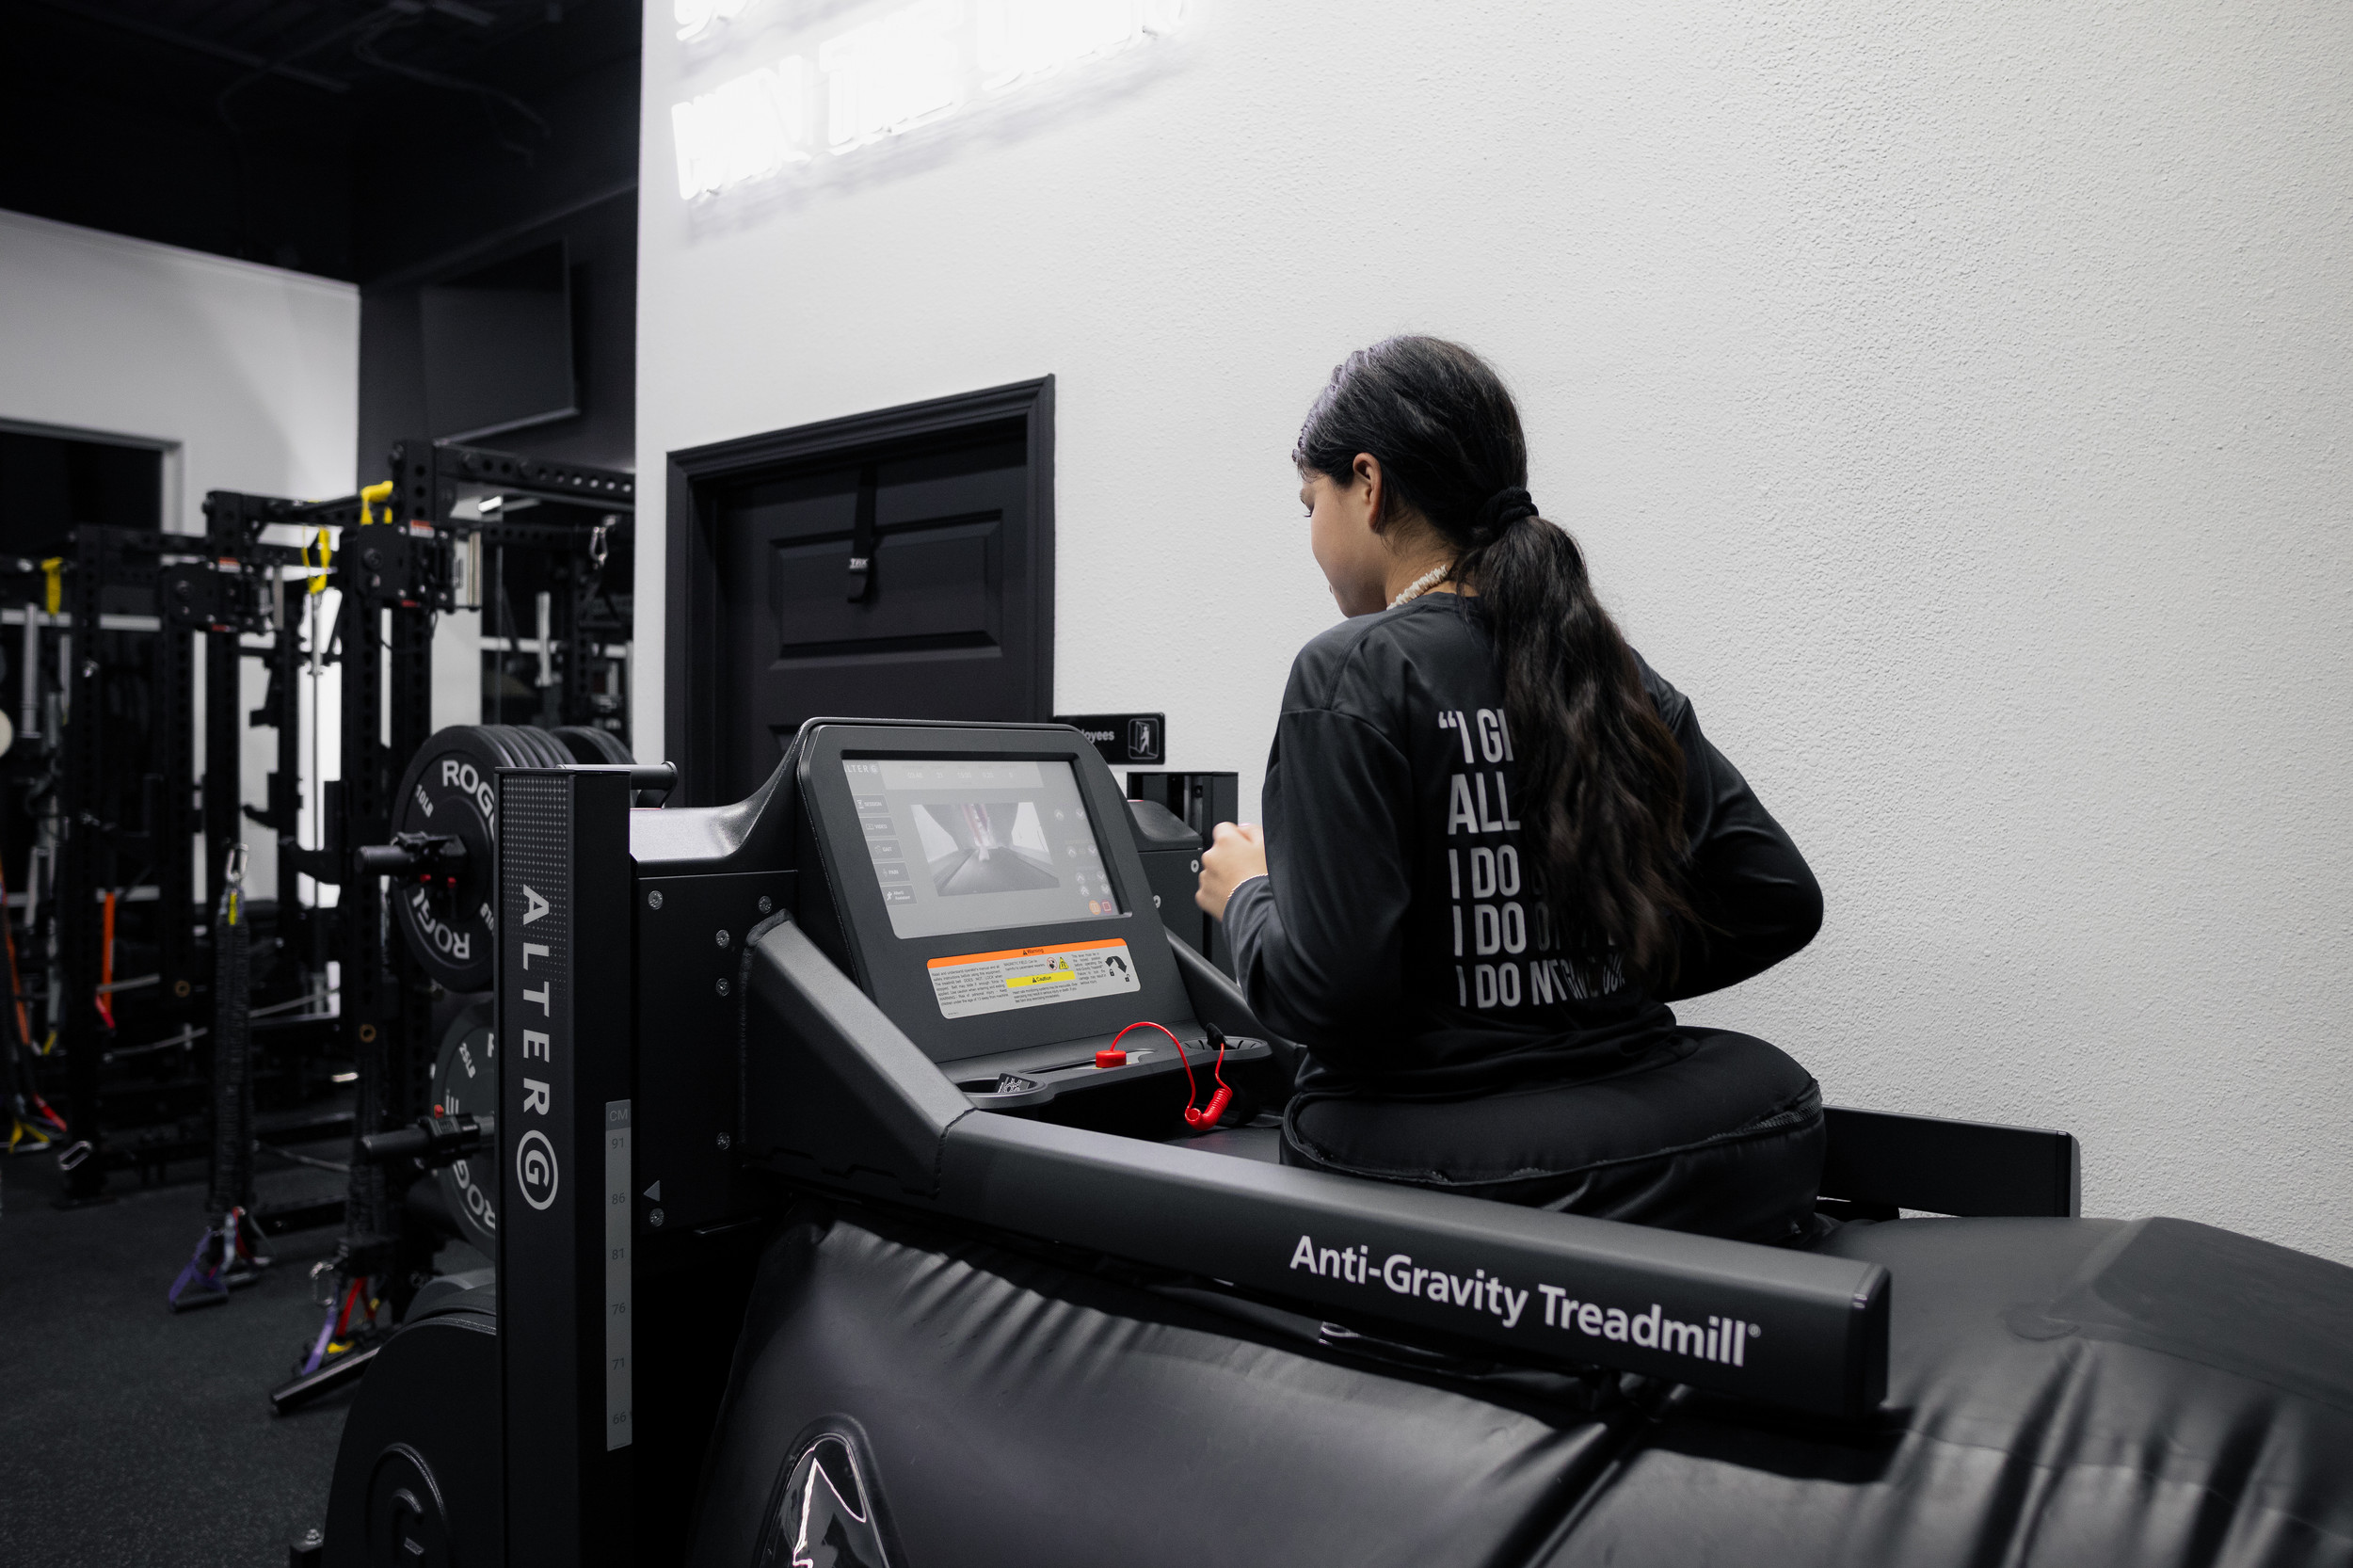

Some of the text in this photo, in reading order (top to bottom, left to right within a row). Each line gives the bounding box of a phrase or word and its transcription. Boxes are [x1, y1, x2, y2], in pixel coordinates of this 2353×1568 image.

[1081, 728, 1114, 744] oyees
[442, 760, 494, 842] ROG
[1448, 772, 1521, 835] ALL
[1449, 844, 1521, 899] I DO
[1452, 905, 1463, 956] I
[1474, 902, 1527, 955] DO
[1456, 966, 1466, 1007] I
[1475, 962, 1521, 1009] DO
[609, 1108, 629, 1122] CM
[612, 1137, 625, 1149] 91
[612, 1192, 626, 1205] 86
[612, 1248, 625, 1260] 81
[1289, 1235, 1529, 1328] Anti-Gravity
[612, 1301, 626, 1316] 76
[612, 1356, 625, 1370] 71
[613, 1411, 627, 1425] 66
